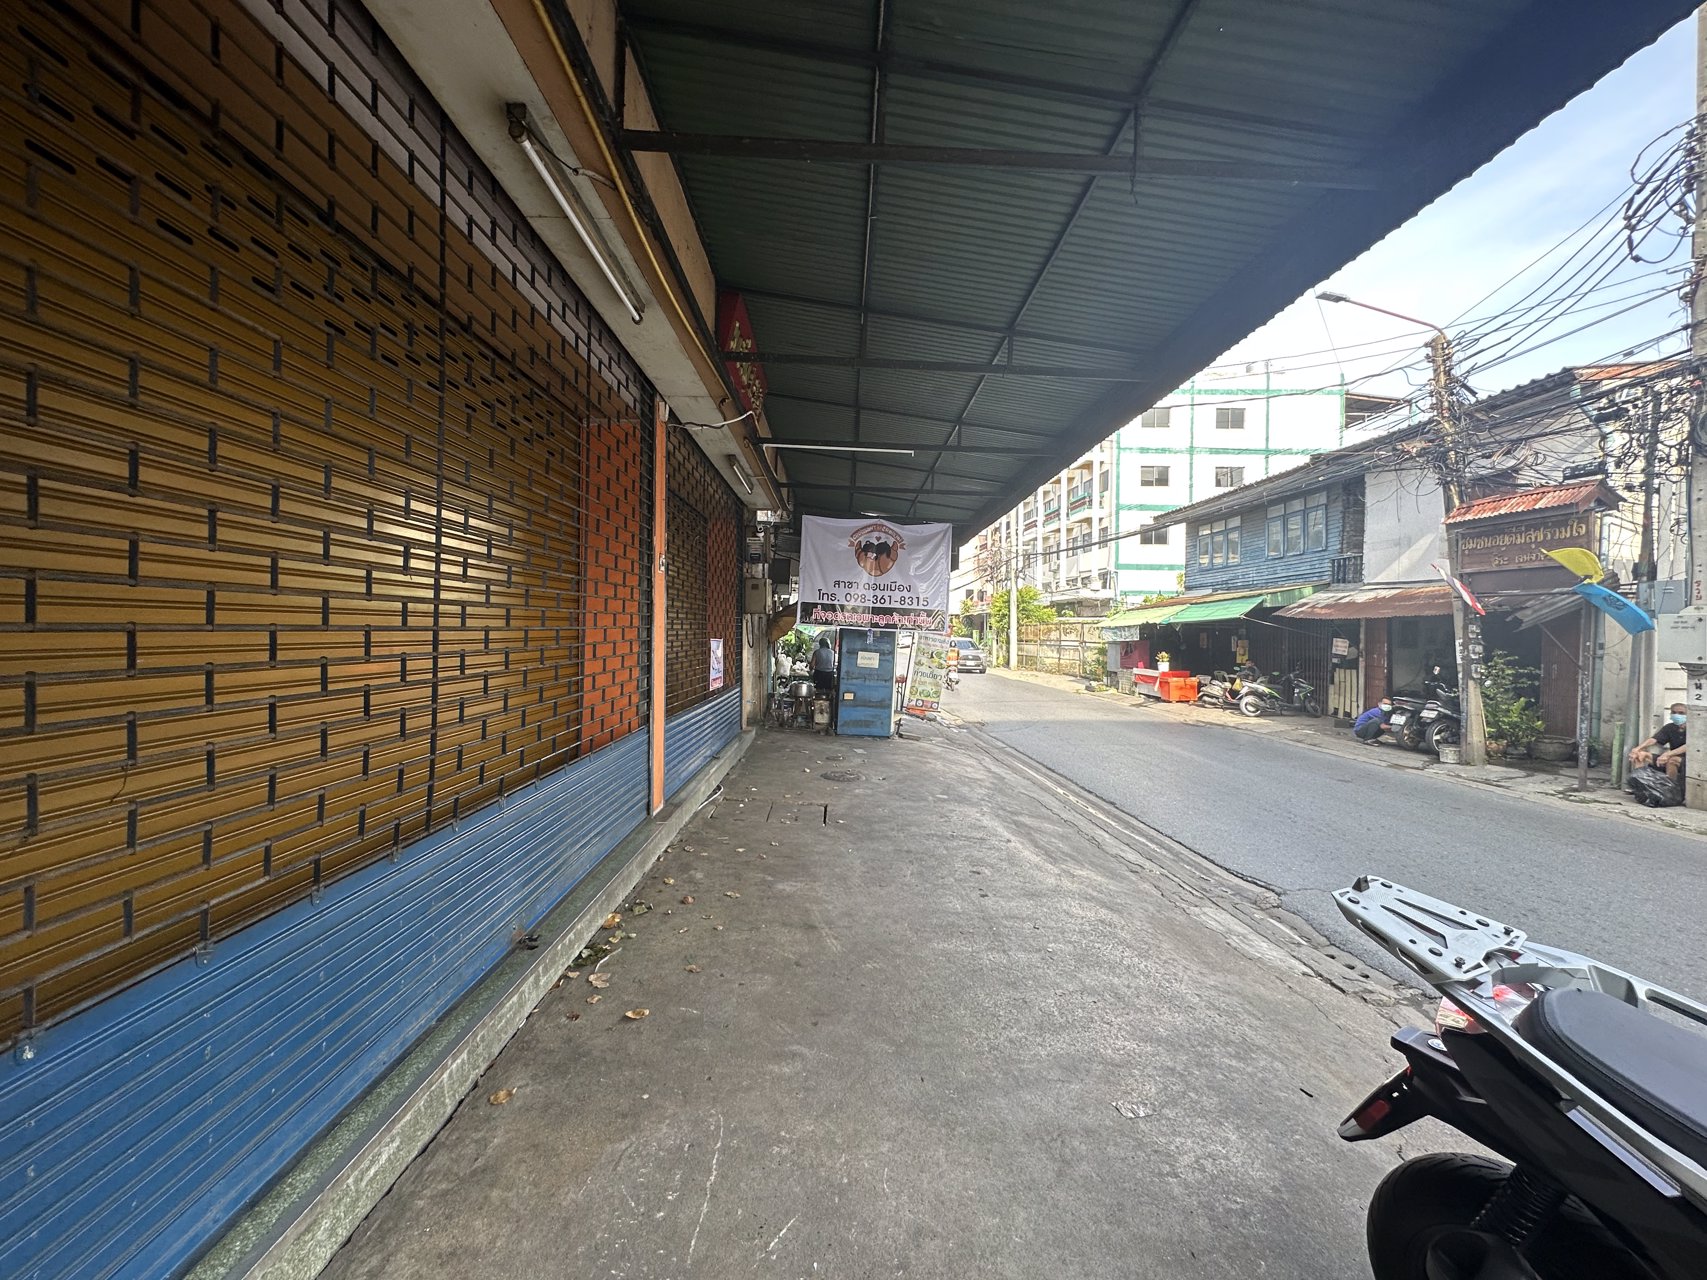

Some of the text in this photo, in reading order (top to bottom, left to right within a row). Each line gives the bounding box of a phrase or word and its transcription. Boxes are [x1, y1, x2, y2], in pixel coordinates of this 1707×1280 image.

[833, 580, 912, 593] สาขา ดอนเมือง
[817, 589, 930, 607] โทร. 098-361-8315
